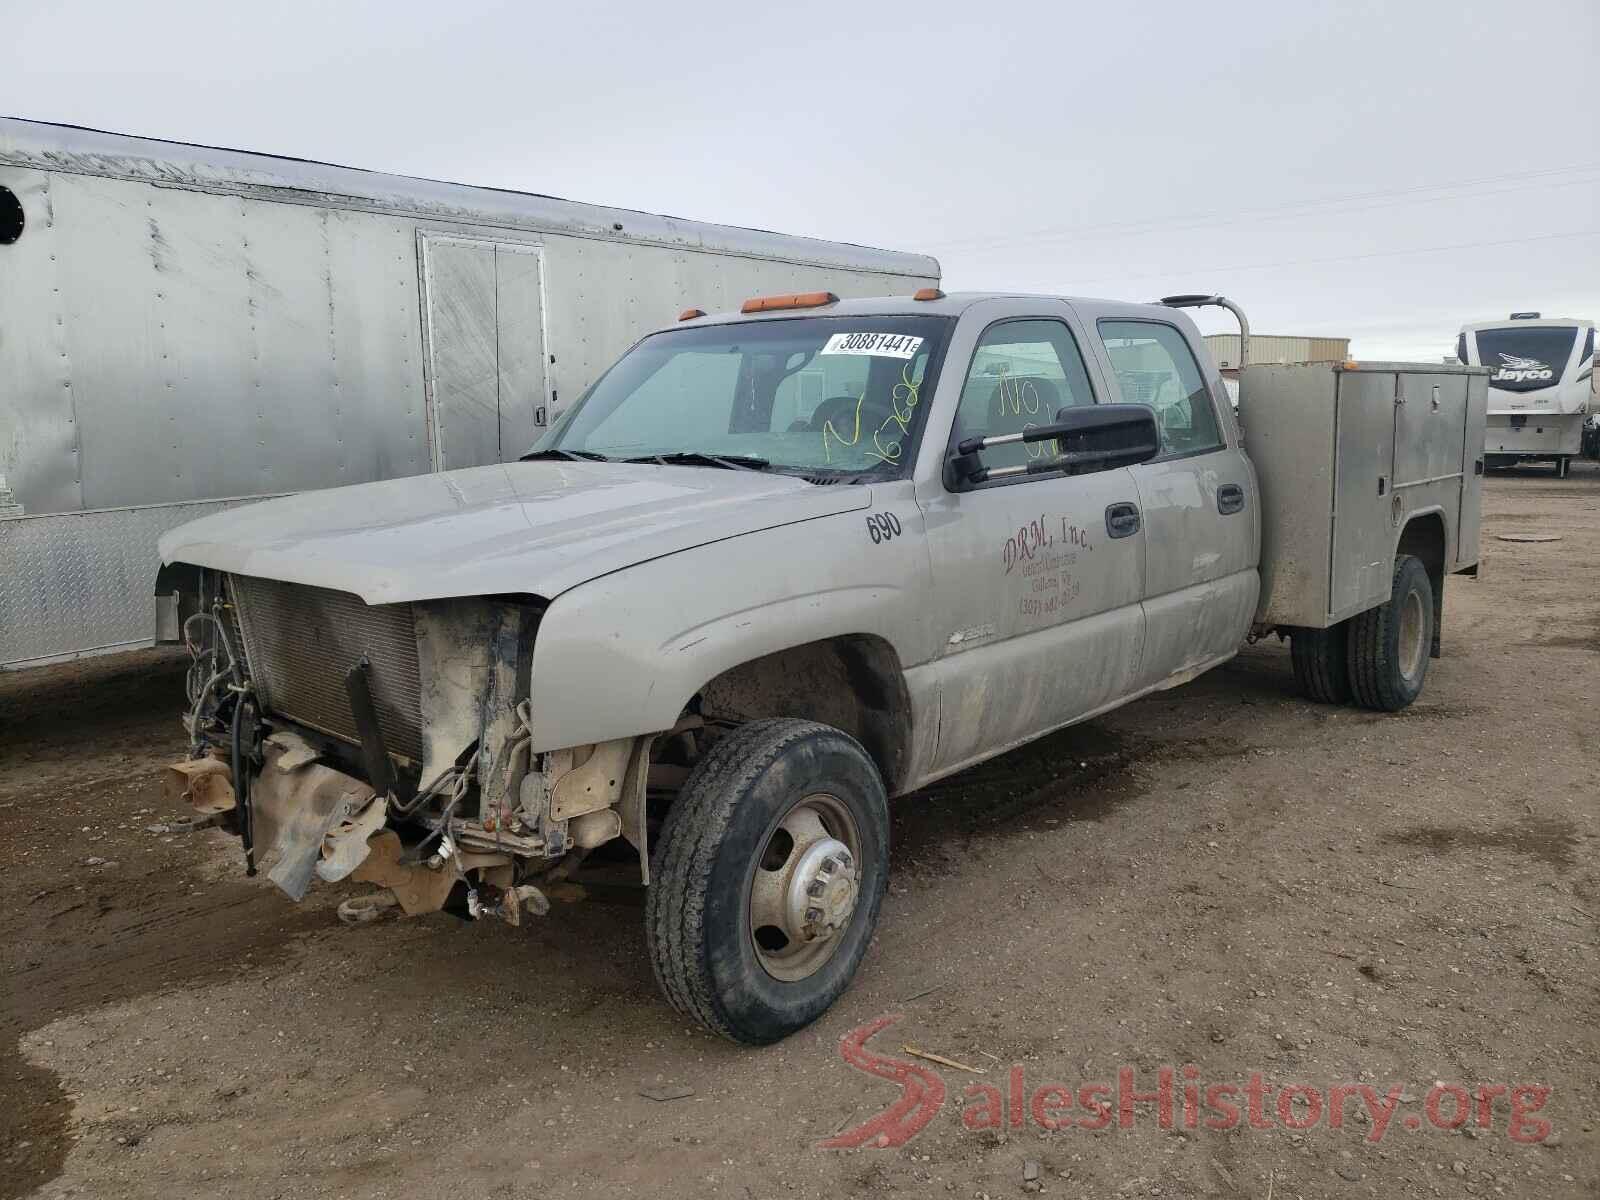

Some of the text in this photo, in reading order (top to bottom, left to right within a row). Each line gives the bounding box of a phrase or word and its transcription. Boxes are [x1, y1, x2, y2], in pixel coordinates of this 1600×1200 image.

[839, 333, 913, 353] 30881441
[1491, 368, 1553, 382] Jayco
[865, 511, 902, 545] 690
[1061, 516, 1094, 552] Inc.
